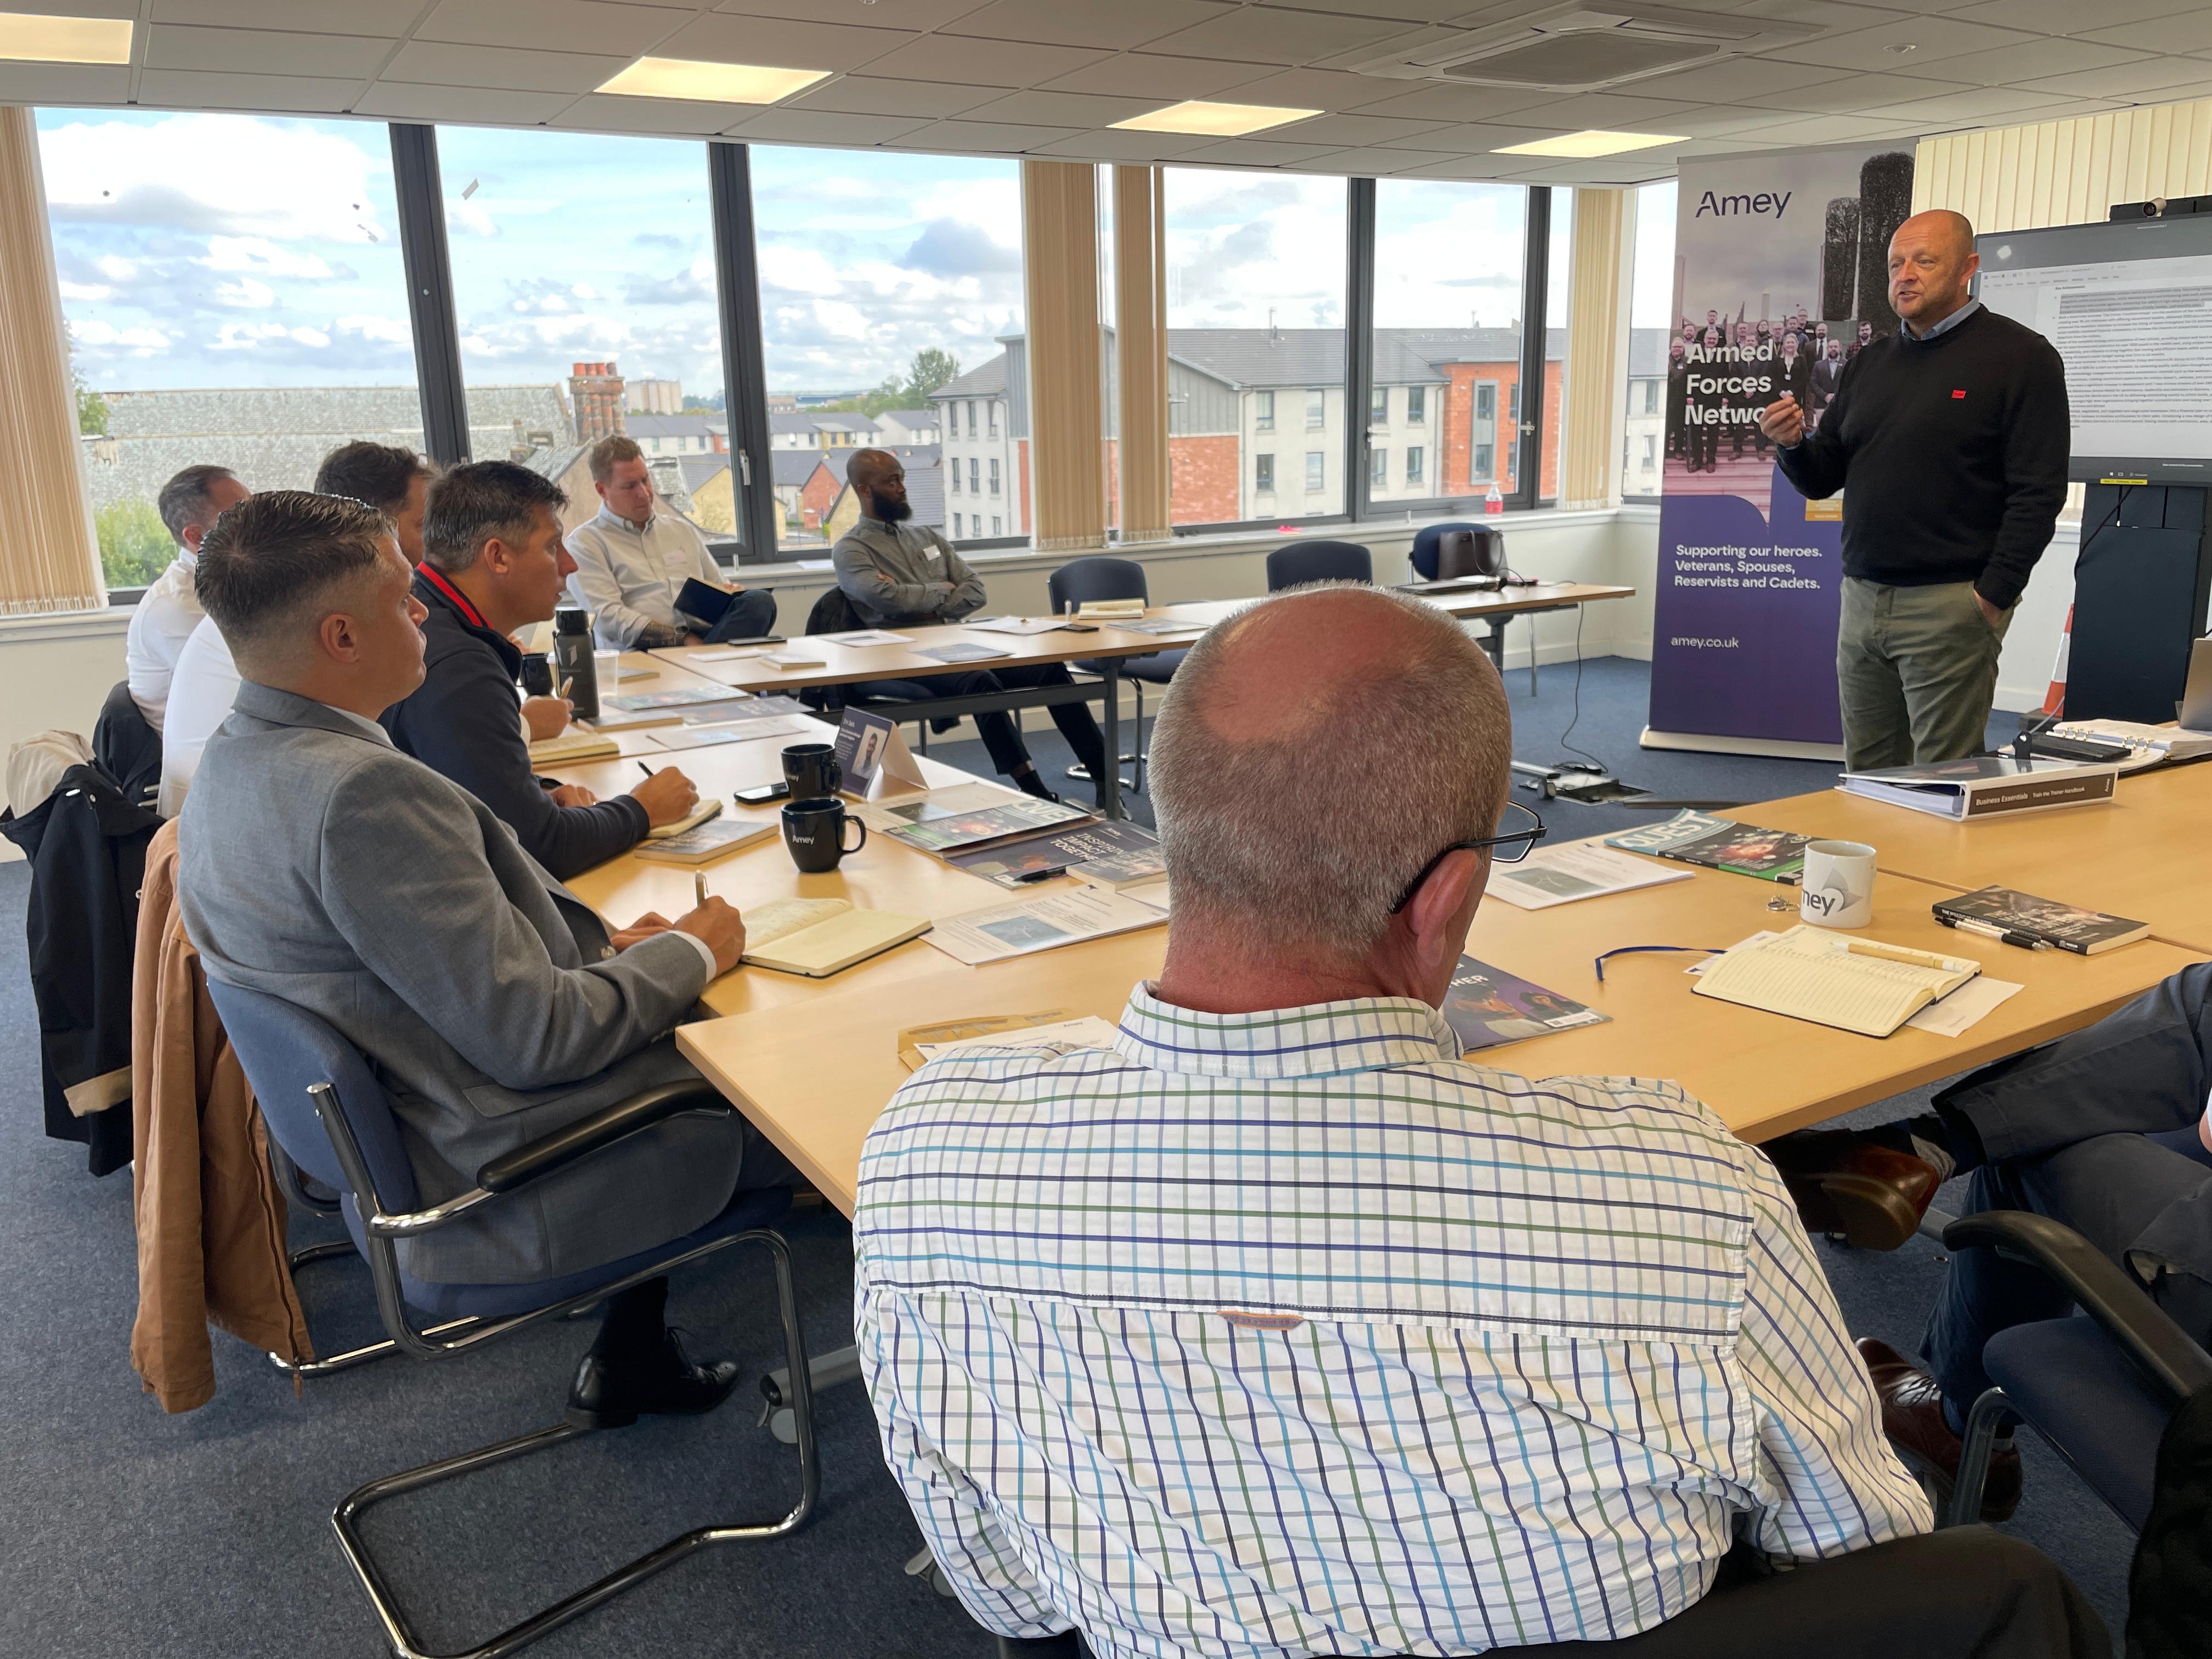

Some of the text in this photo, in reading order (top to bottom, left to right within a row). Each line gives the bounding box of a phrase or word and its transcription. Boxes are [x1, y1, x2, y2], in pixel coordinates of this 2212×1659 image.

[1695, 191, 1792, 218] Amey
[1687, 339, 1774, 364] Armed
[1686, 373, 1772, 395] Forces
[1684, 404, 1766, 425] Netwo
[1675, 544, 1822, 558] Supporting our heroes.
[1675, 561, 1795, 574] Veterans, Spouses,
[1674, 575, 1820, 589] Reservists and Cadets.
[1671, 636, 1739, 649] amey.co.uk
[1976, 797, 2000, 806] Business
[2001, 792, 2028, 803] Essentials
[1616, 809, 1716, 848] QUEST
[792, 835, 815, 845] Amey
[1050, 839, 1099, 861] TOGETHE
[1063, 836, 1107, 855] IMPACT
[1076, 833, 1125, 855] INSPIRIN
[1802, 888, 1836, 916] mey
